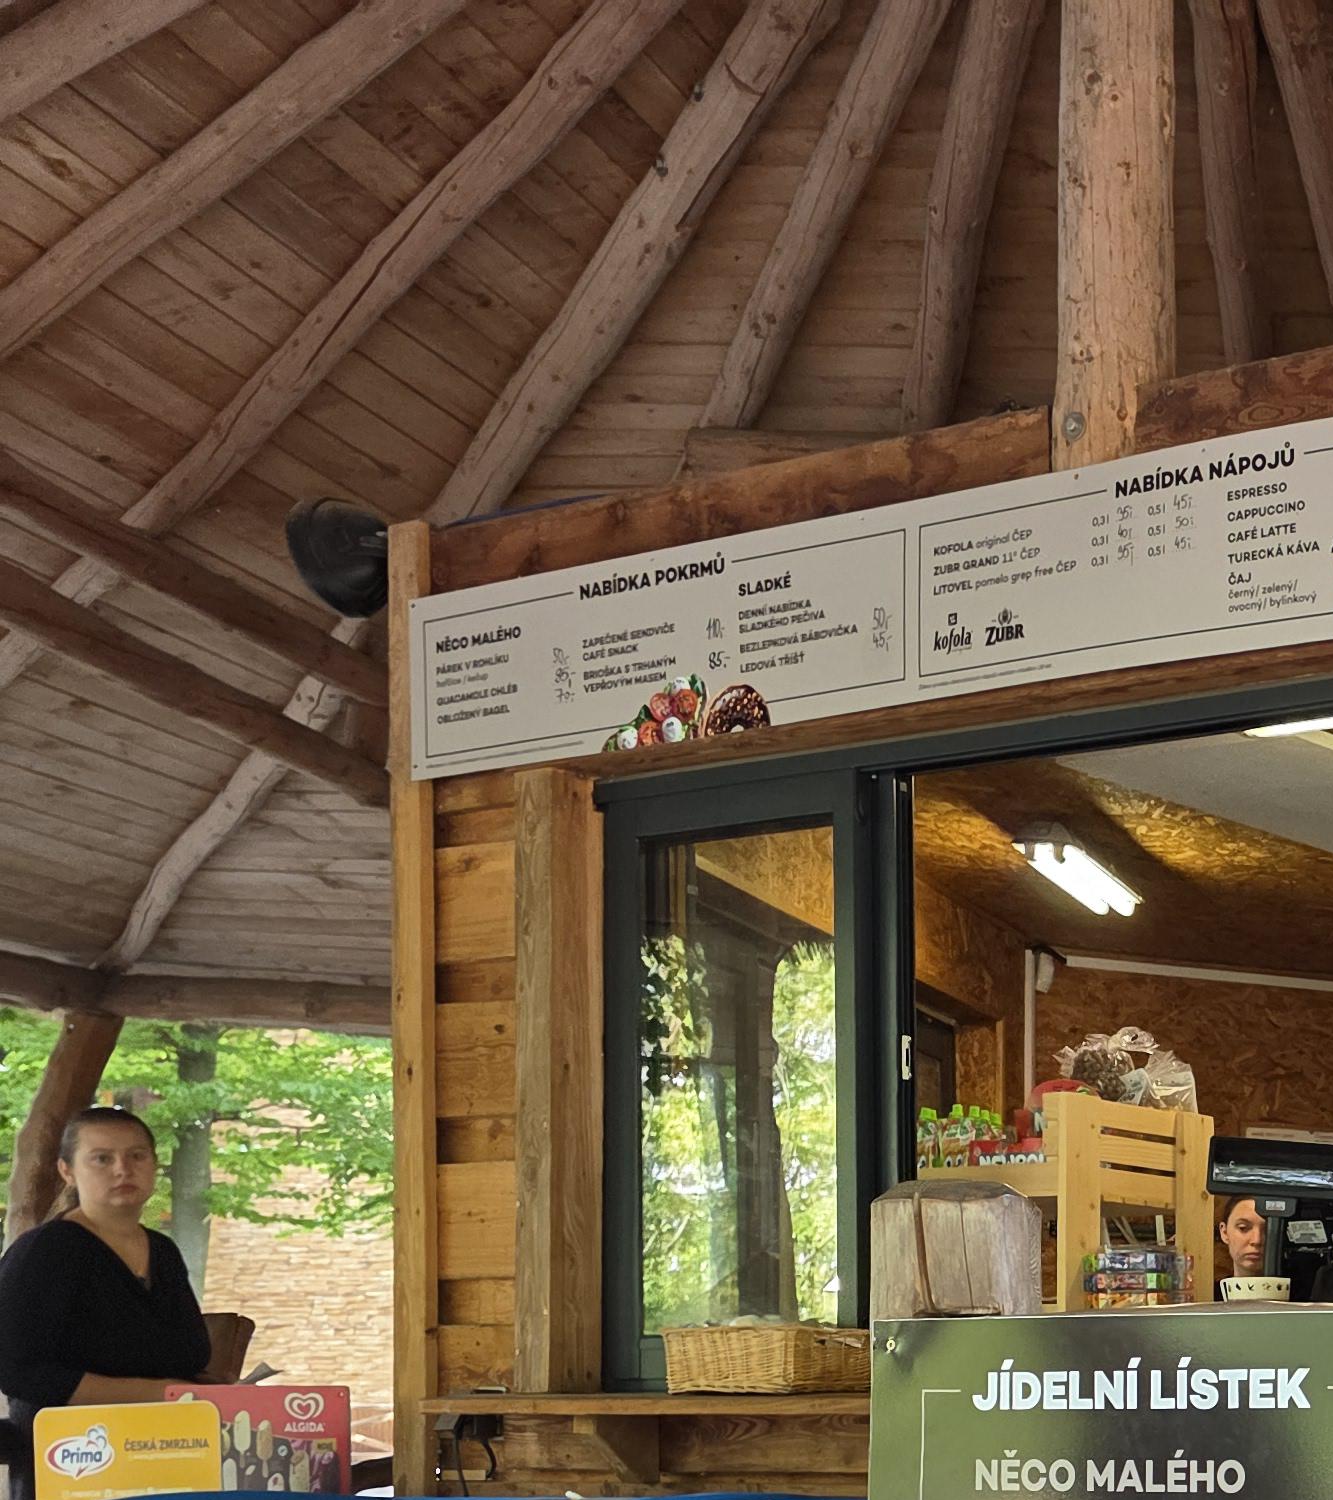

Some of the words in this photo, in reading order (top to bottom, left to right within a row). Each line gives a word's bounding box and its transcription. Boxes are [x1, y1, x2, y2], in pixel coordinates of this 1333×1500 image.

[1115, 465, 1204, 499] NABÍDKA
[1210, 442, 1294, 480] NÁPOJŮ
[1228, 482, 1287, 501] ESPRESSO
[1228, 500, 1305, 522] CAPPUCCINO
[934, 540, 973, 556] KOFOLA
[1012, 529, 1032, 541] ČEP
[1228, 526, 1257, 542] CAFÉ
[1261, 523, 1296, 538] LATTE
[934, 563, 960, 576] ZUBR
[963, 556, 999, 570] GRAND
[1020, 547, 1040, 560] ČEP
[1228, 544, 1283, 564] TURECKÁ
[1287, 540, 1320, 554] KÁVA
[580, 572, 650, 600] NABÍDKA
[656, 552, 724, 585] POKRMŮ
[738, 571, 791, 596] SLADKÉ
[934, 580, 972, 596] LITOVEL
[1034, 566, 1053, 576] free
[1056, 560, 1076, 572] ČEP
[1228, 572, 1251, 585] ČAJ
[436, 636, 468, 654] NĚCO
[472, 626, 521, 646] MALÉHO
[934, 626, 971, 654] kofola
[986, 624, 1024, 646] ZUBR
[972, 1357, 1141, 1410] JÍDELNÍ
[1150, 1357, 1310, 1409] LÍSTEK
[284, 1422, 324, 1432] ALGIDA
[62, 1448, 102, 1464] Prima
[976, 1450, 1075, 1492] NĚCO
[1087, 1450, 1245, 1493] MALÉHO
